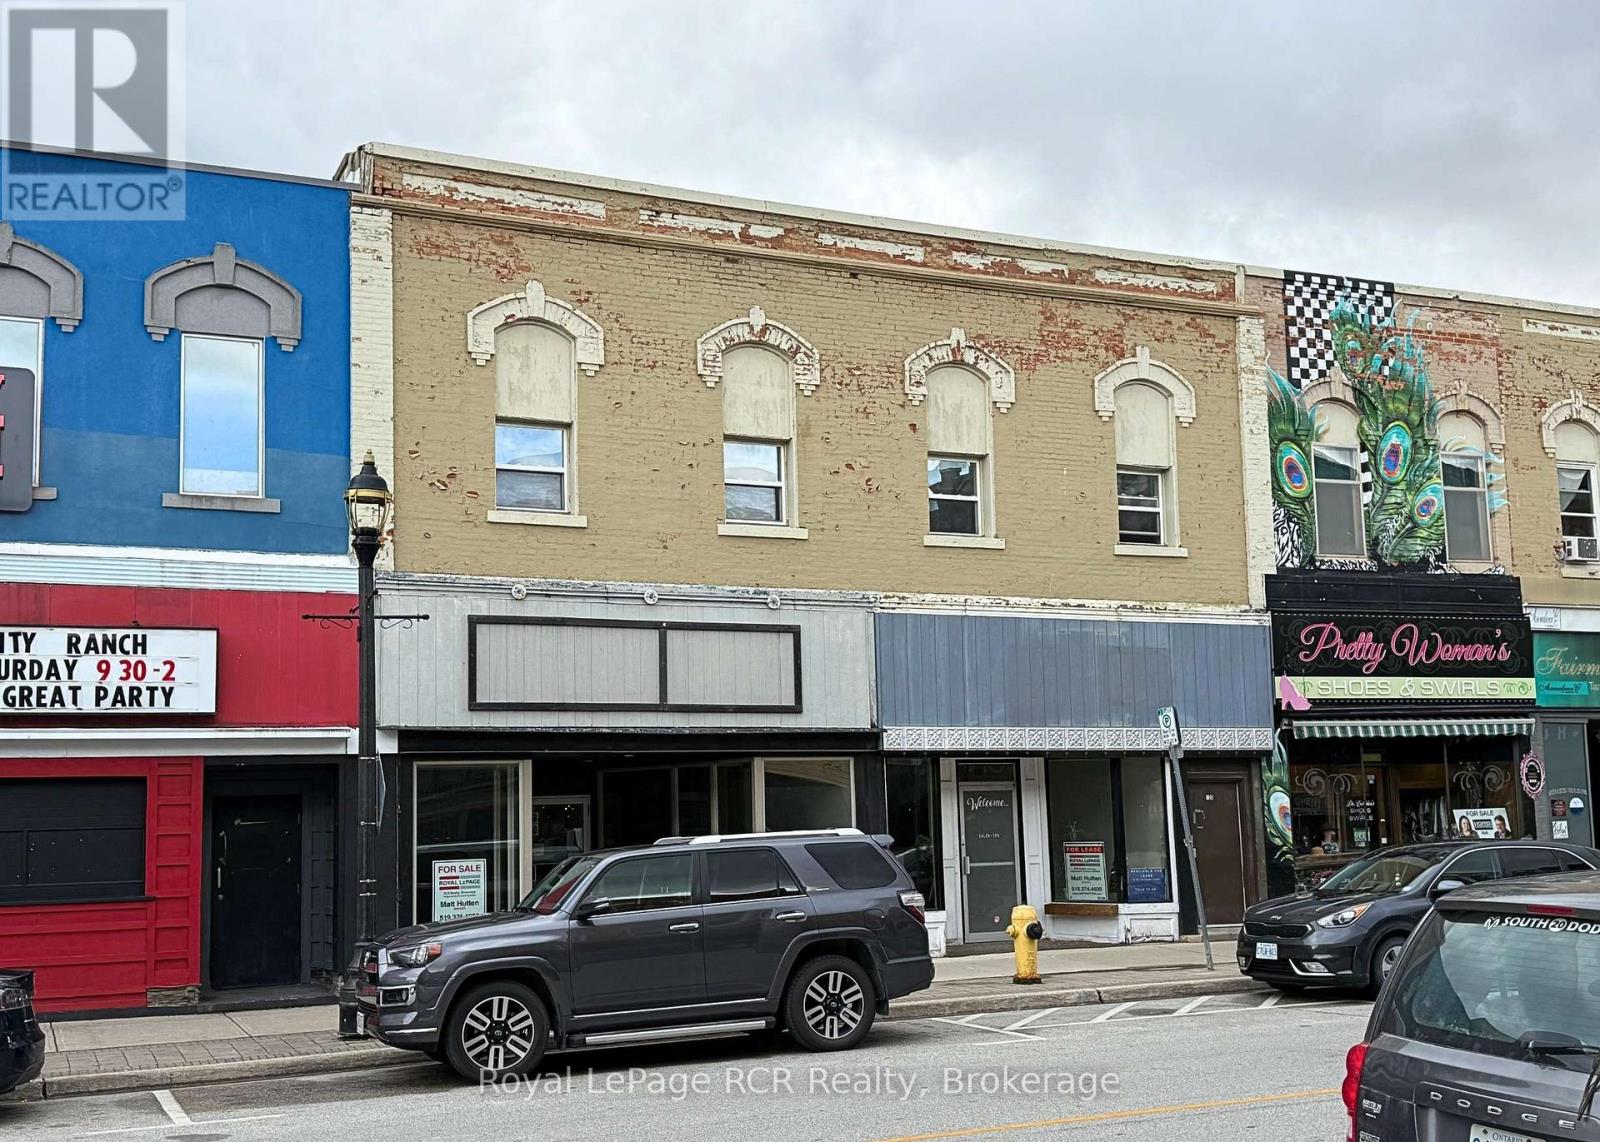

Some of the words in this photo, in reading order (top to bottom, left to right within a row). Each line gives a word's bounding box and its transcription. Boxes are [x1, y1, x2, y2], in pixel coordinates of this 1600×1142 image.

[67, 633, 148, 656] RANCH
[1299, 622, 1387, 675] Pretty
[1391, 623, 1511, 667] Woman's
[2, 686, 83, 708] GREAT
[95, 686, 175, 708] PARTY
[1318, 680, 1391, 696] SHOES
[1400, 678, 1415, 697] &
[1420, 680, 1500, 696] SWIRLS
[438, 865, 457, 873] FOR
[459, 864, 481, 872] SALE
[1501, 916, 1548, 929] SOUTH
[1430, 1091, 1576, 1131] DODGE
